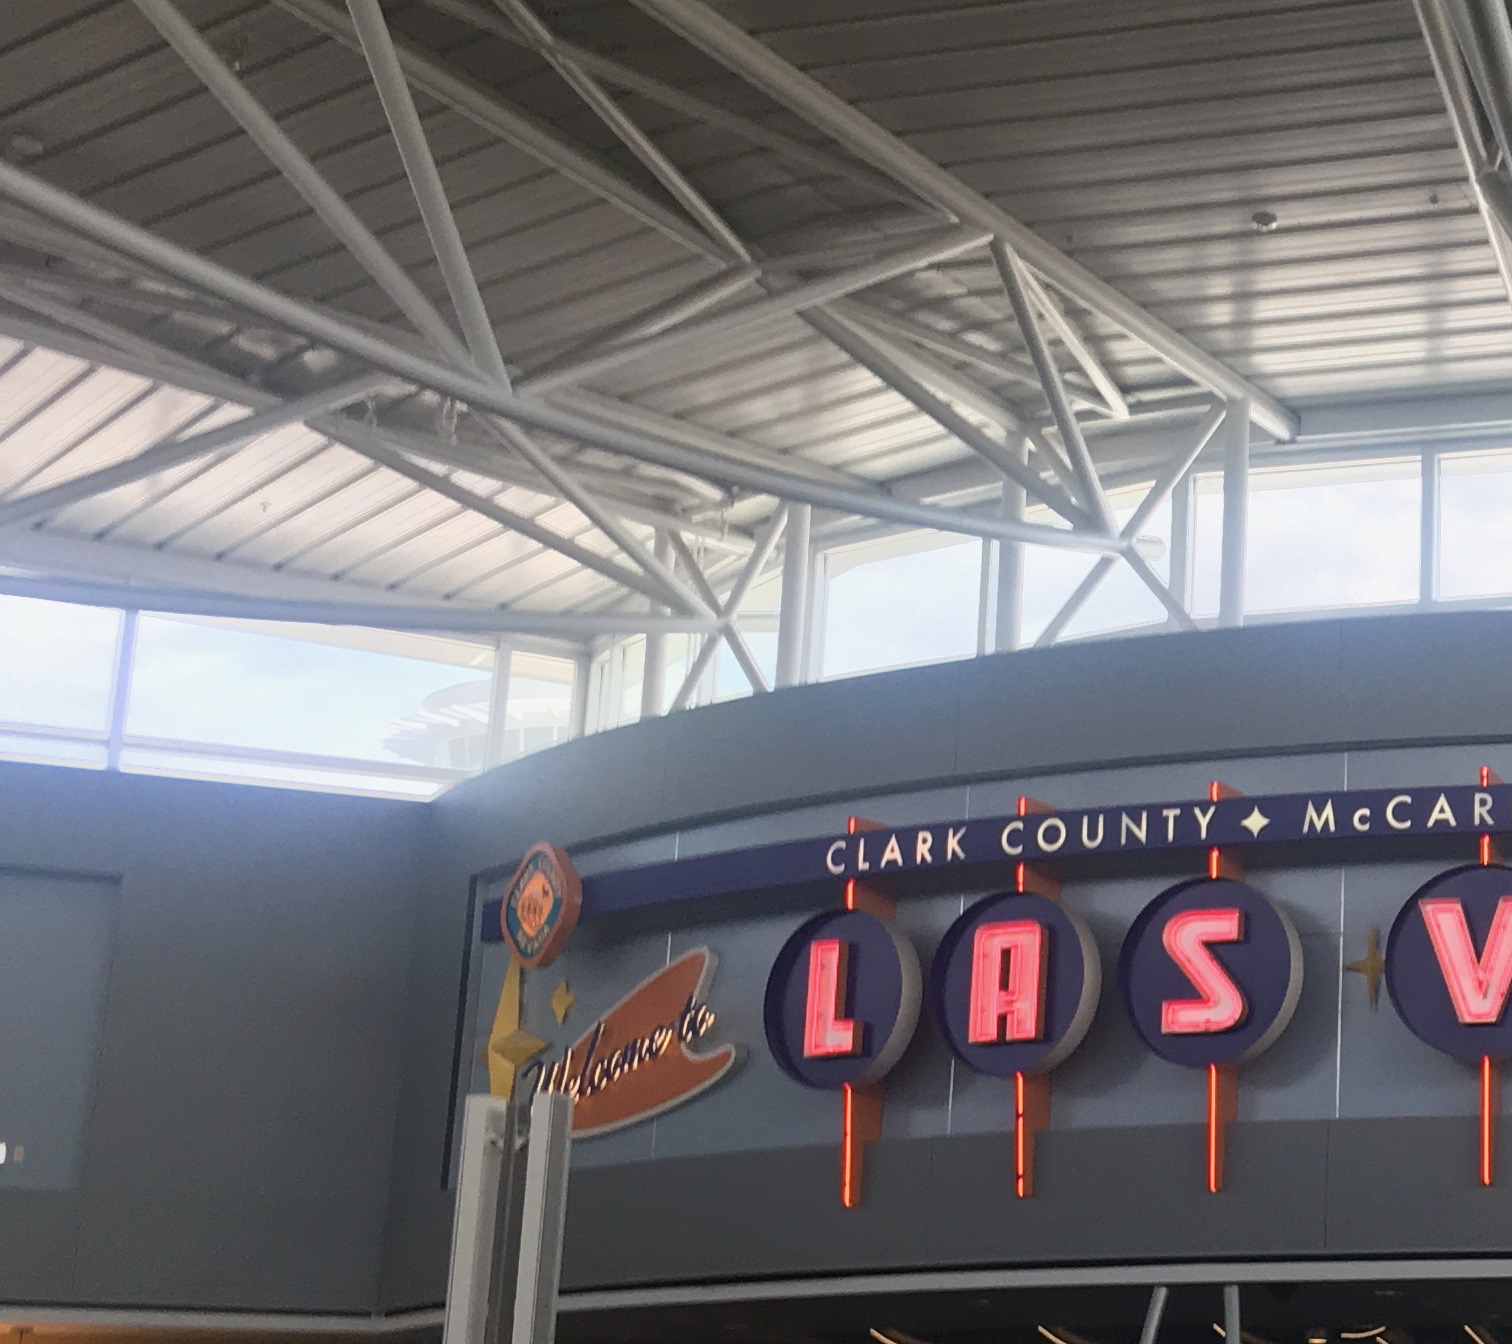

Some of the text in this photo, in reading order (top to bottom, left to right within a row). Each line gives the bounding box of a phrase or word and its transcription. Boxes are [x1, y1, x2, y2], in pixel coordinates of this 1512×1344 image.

[826, 826, 968, 875] CLARK
[1002, 805, 1217, 855] COUNTY
[678, 992, 716, 1044] to
[803, 908, 1247, 1058] LAS
